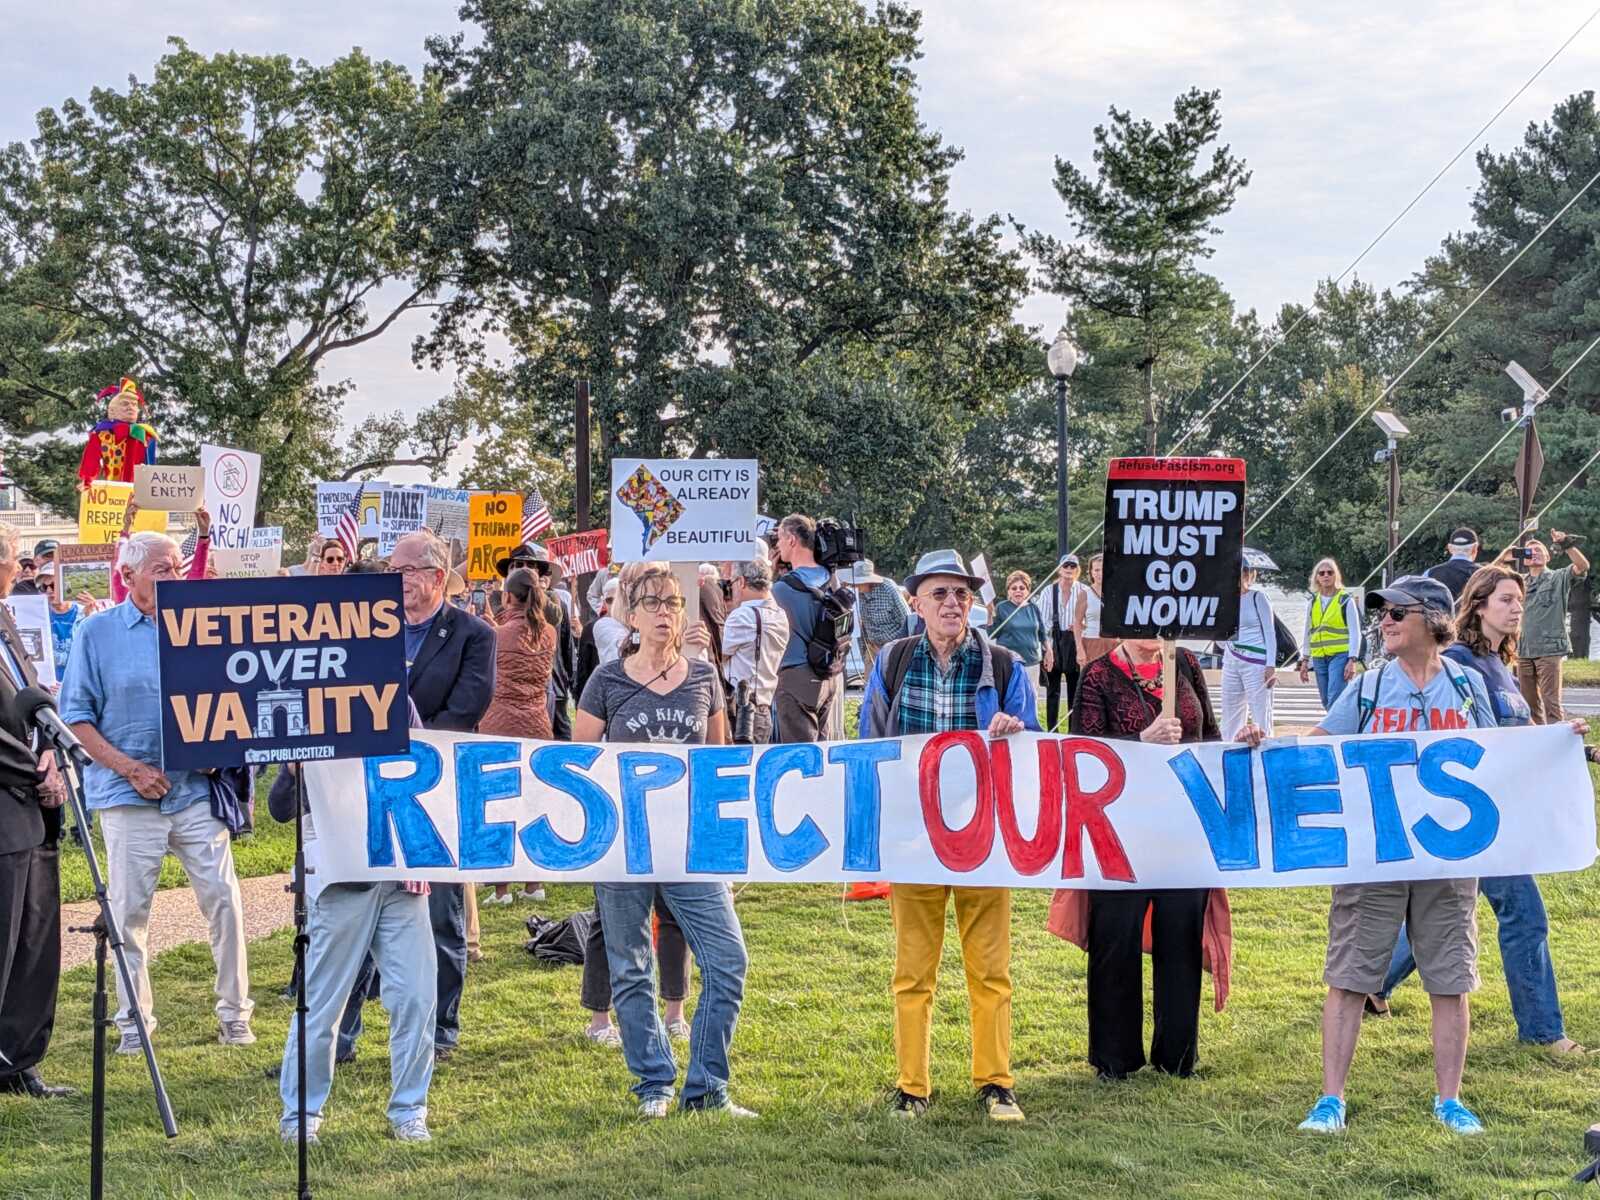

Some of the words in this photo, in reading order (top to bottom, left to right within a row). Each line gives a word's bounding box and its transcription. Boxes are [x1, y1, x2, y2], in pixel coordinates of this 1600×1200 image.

[660, 469, 694, 482] OUR
[697, 469, 731, 482] CITY
[735, 469, 750, 482] IS
[1118, 459, 1235, 474] RefuseFascism.org
[151, 472, 187, 484] ARCH
[87, 489, 108, 505] NO
[151, 486, 197, 498] ENEMY
[676, 487, 751, 500] ALREADY
[220, 503, 242, 524] NO
[382, 490, 424, 521] HONK!
[485, 500, 507, 516] NO
[1112, 489, 1237, 521] TRUMP
[390, 521, 423, 531] SUPPORT
[473, 522, 521, 537] TRUMP
[104, 530, 121, 544] VE
[667, 530, 755, 544] BEAUTIFUL
[1123, 524, 1224, 557] MUST
[469, 544, 513, 574] ARC
[557, 549, 600, 579] SANITY
[1145, 560, 1197, 592] GO
[1124, 595, 1220, 627] NOW!
[161, 599, 402, 648] VETERANS
[225, 647, 348, 684] OVER
[169, 683, 400, 743] VAITY
[625, 712, 649, 734] NO
[655, 707, 702, 732] KINGS
[270, 745, 336, 761] PUBLICCITIZEN
[364, 740, 901, 874] RESPECT
[918, 730, 1137, 883] OUR
[1167, 737, 1501, 873] VETS
